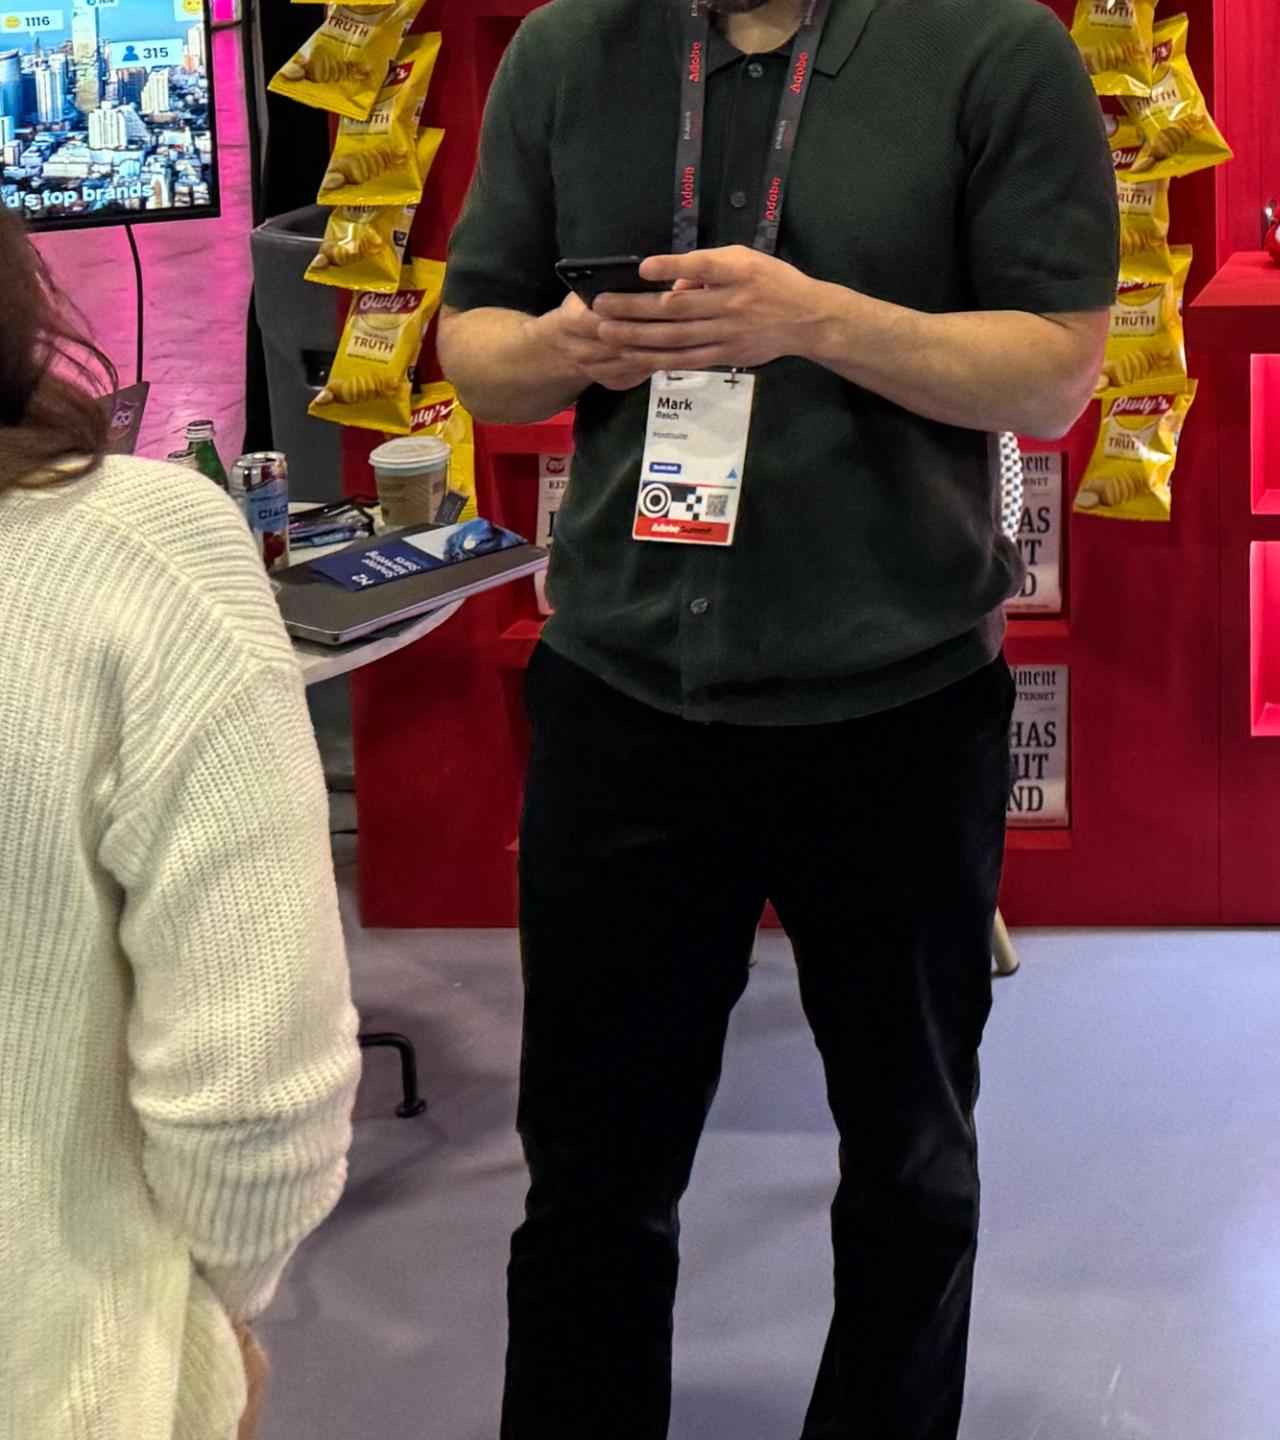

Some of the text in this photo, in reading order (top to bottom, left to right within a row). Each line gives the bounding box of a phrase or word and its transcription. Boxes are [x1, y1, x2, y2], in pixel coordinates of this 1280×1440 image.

[25, 15, 50, 27] 1116
[327, 16, 369, 38] TRUTH
[143, 47, 169, 59] 315
[42, 188, 78, 208] top
[82, 182, 154, 203] brands
[1118, 192, 1152, 206] RUTH
[359, 292, 417, 313] Owly's
[1114, 315, 1156, 328] TRUTH
[353, 336, 394, 354] TRUTH
[657, 396, 693, 411] Mark
[1018, 506, 1051, 534] AS
